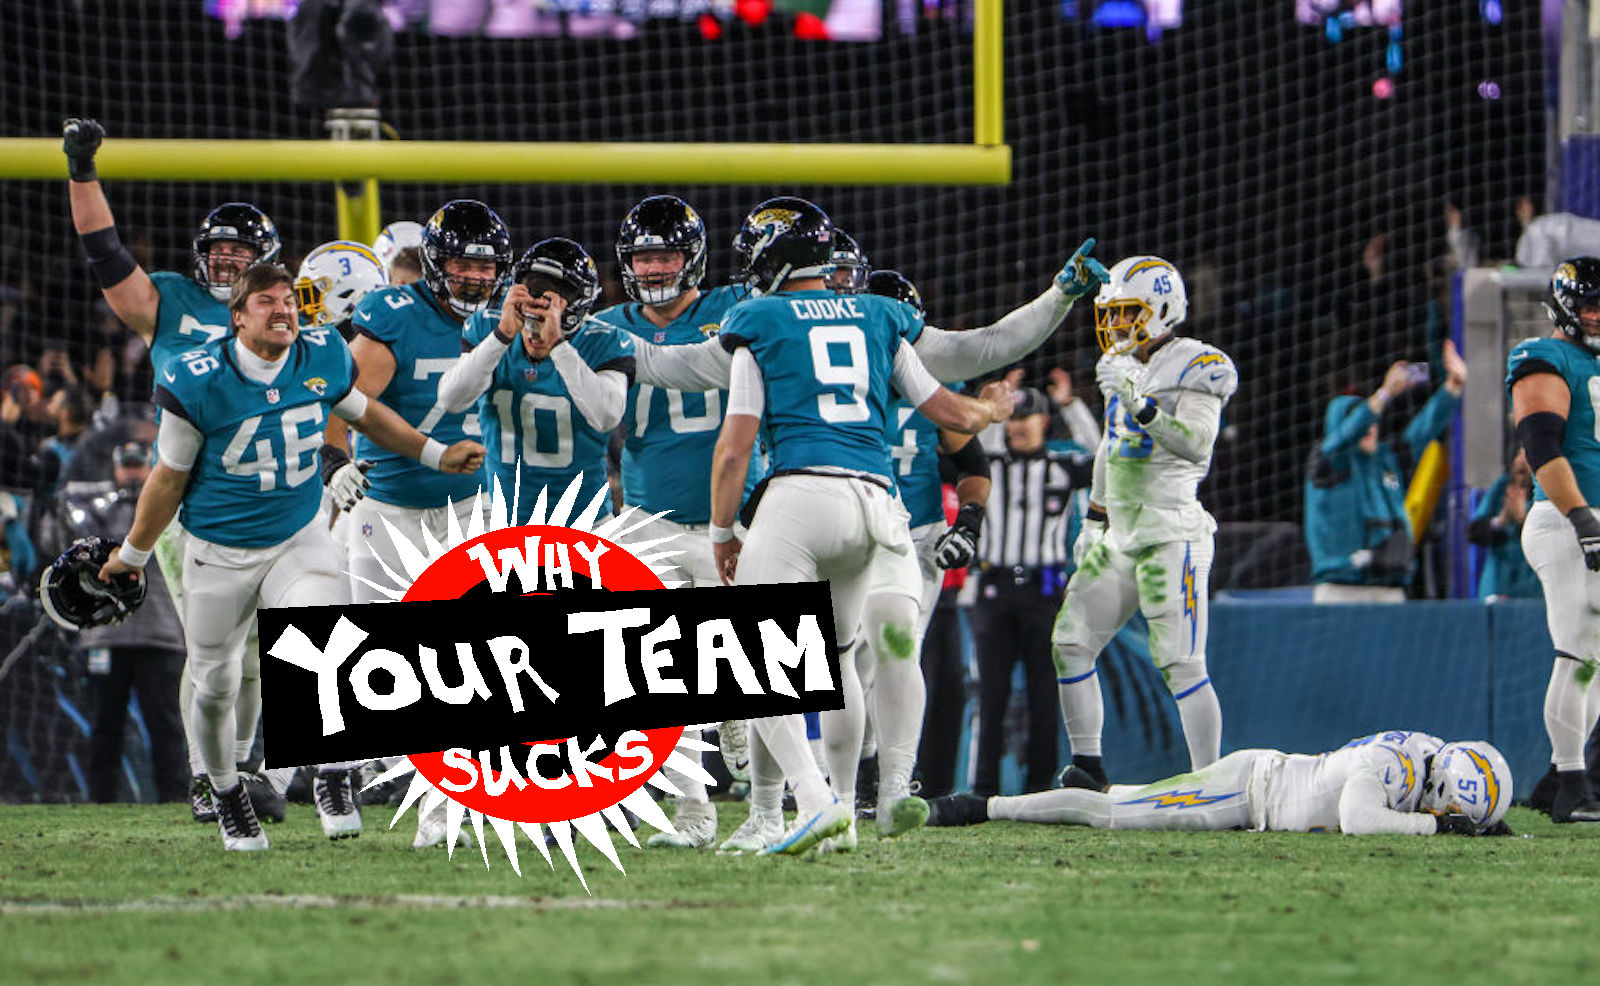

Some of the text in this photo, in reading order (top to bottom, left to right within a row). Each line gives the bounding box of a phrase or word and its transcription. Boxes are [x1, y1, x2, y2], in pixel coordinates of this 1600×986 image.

[338, 257, 351, 276] 3
[1153, 274, 1172, 295] 45
[790, 298, 865, 320] COOKE
[181, 349, 220, 377] 46
[808, 325, 871, 424] 9
[493, 389, 574, 469] 10
[221, 402, 324, 493] 46
[1458, 778, 1477, 806] 57
